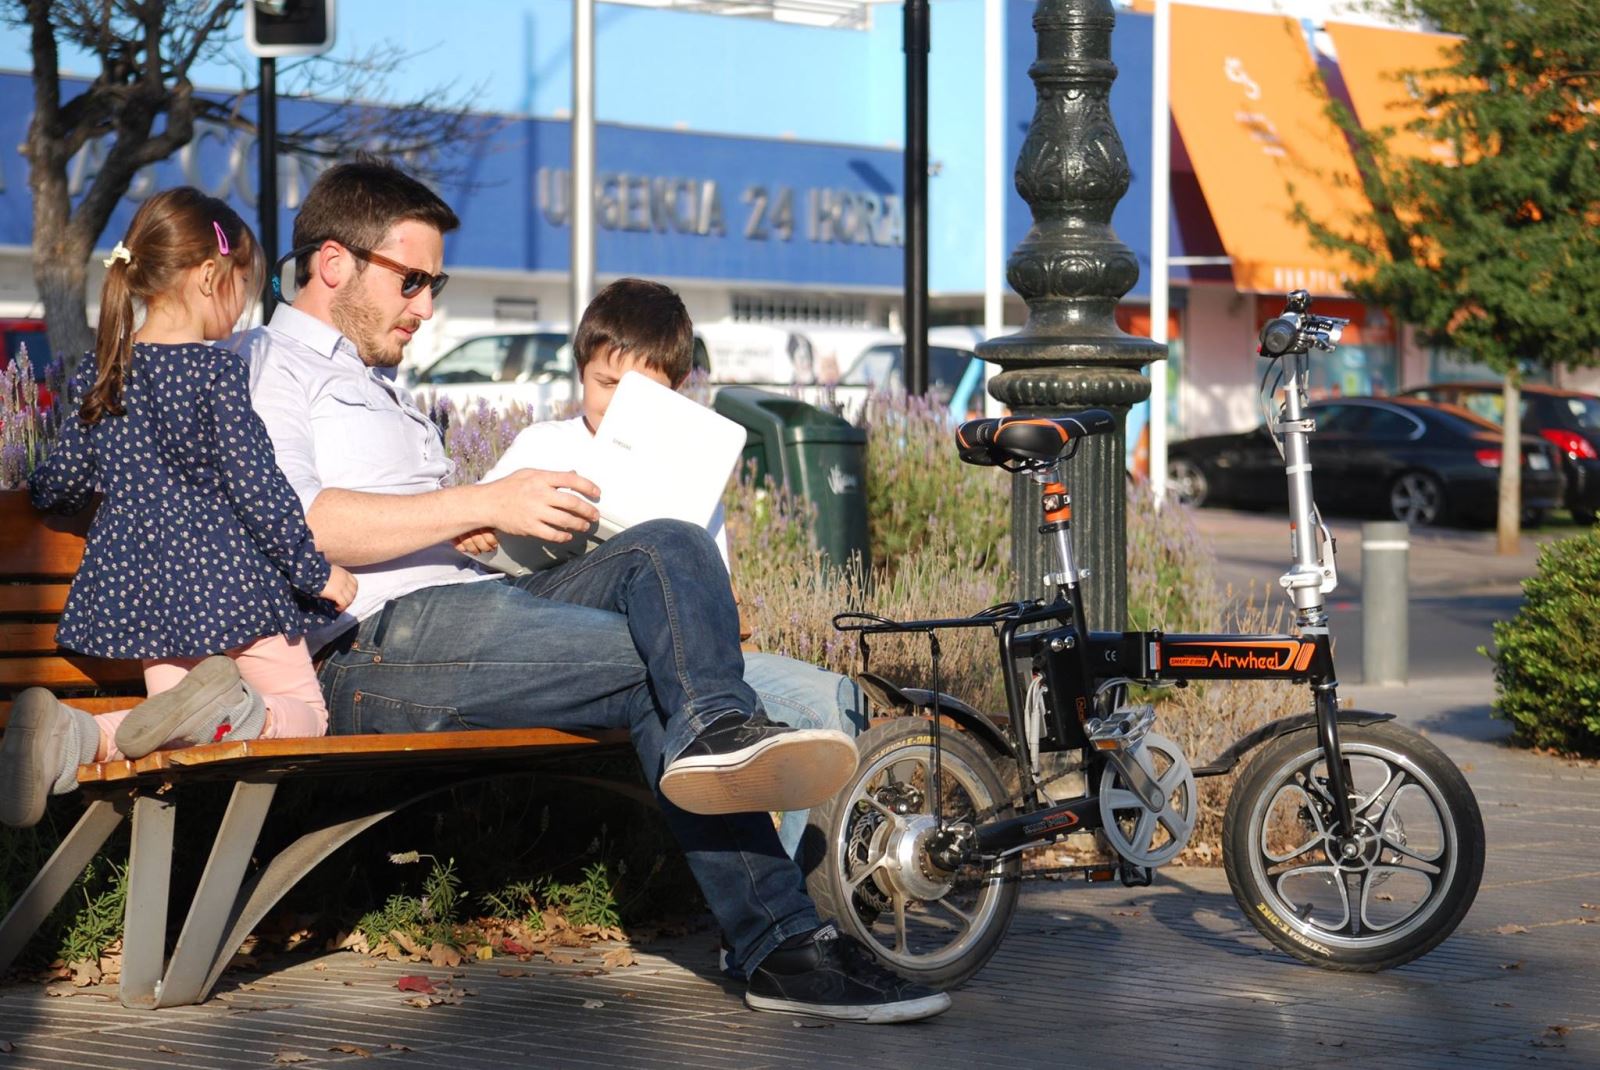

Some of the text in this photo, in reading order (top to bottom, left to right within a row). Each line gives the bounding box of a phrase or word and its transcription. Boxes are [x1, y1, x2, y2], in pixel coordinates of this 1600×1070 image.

[537, 166, 726, 237] UGENCIA
[740, 183, 796, 241] 24
[1208, 649, 1279, 670] Airwheel
